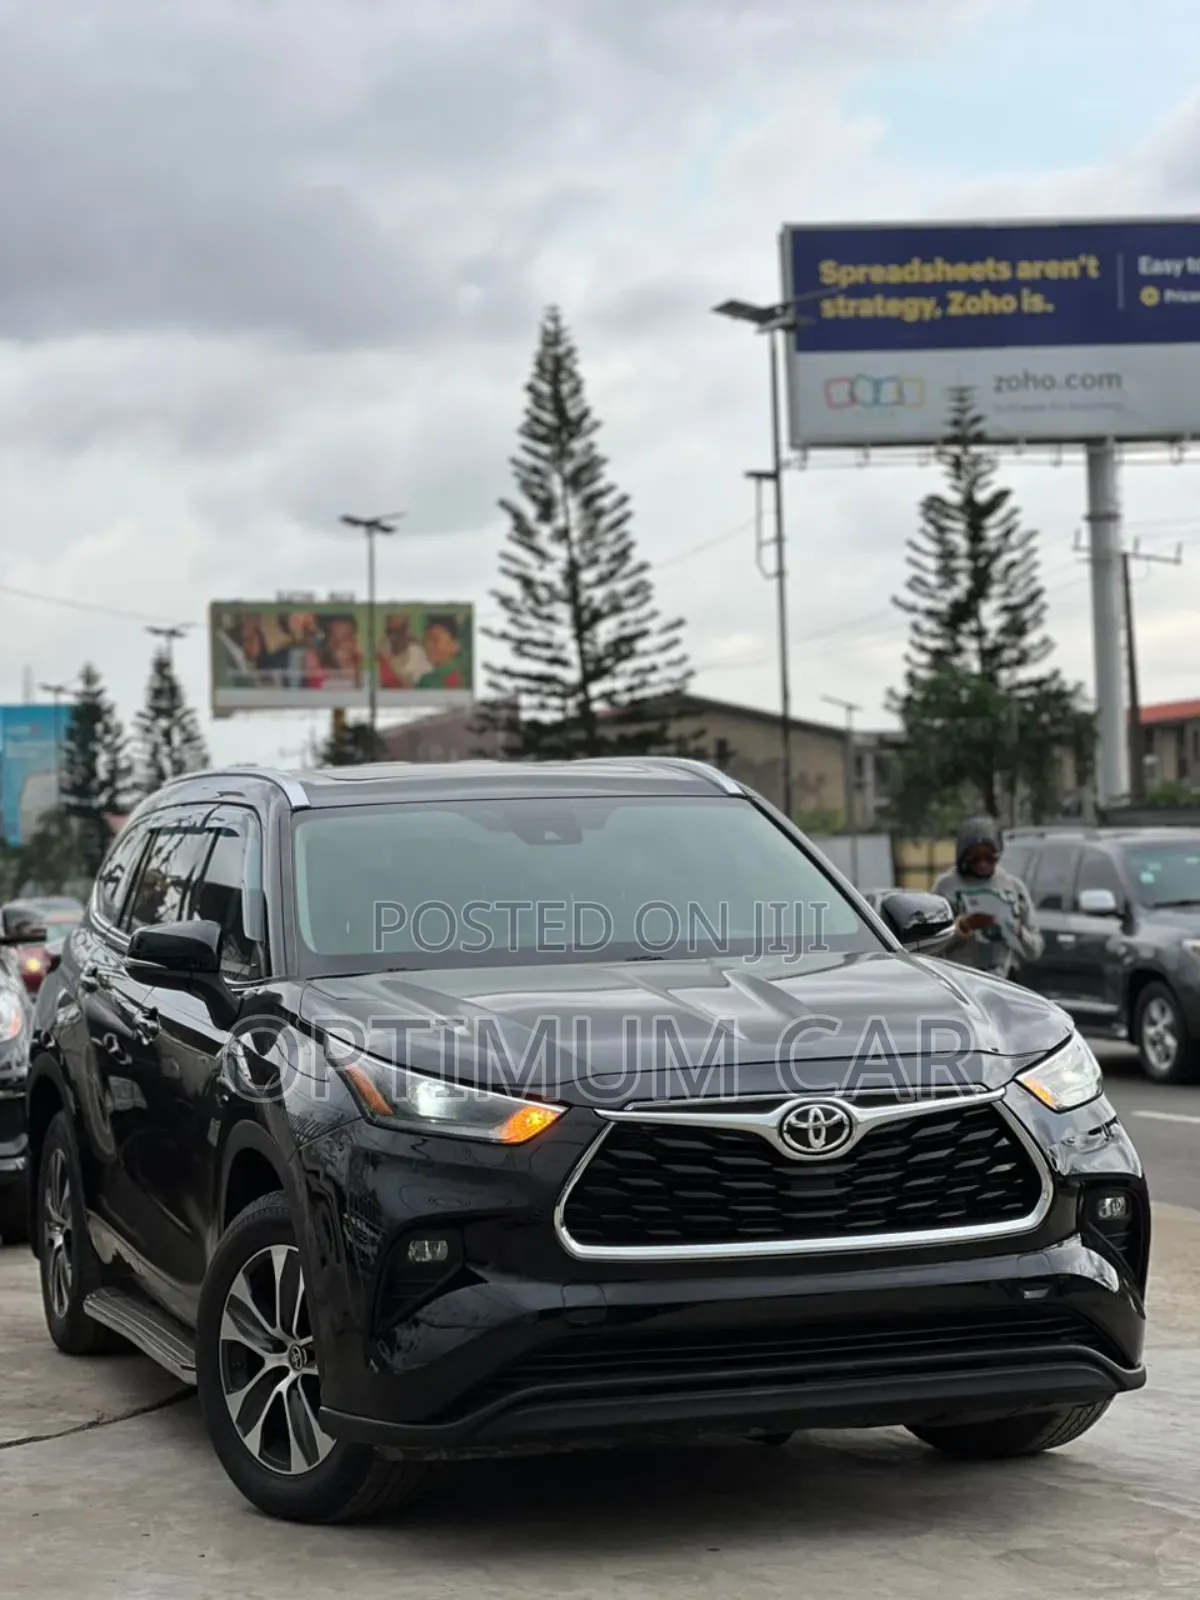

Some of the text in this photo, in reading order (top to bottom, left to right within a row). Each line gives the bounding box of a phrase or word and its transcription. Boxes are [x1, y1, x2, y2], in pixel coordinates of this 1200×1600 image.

[819, 254, 1099, 287] Spreadsheets aren't
[1138, 255, 1184, 278] Easy
[820, 288, 1055, 322] strategy, Zoho is.
[993, 367, 1122, 393] zoho.com
